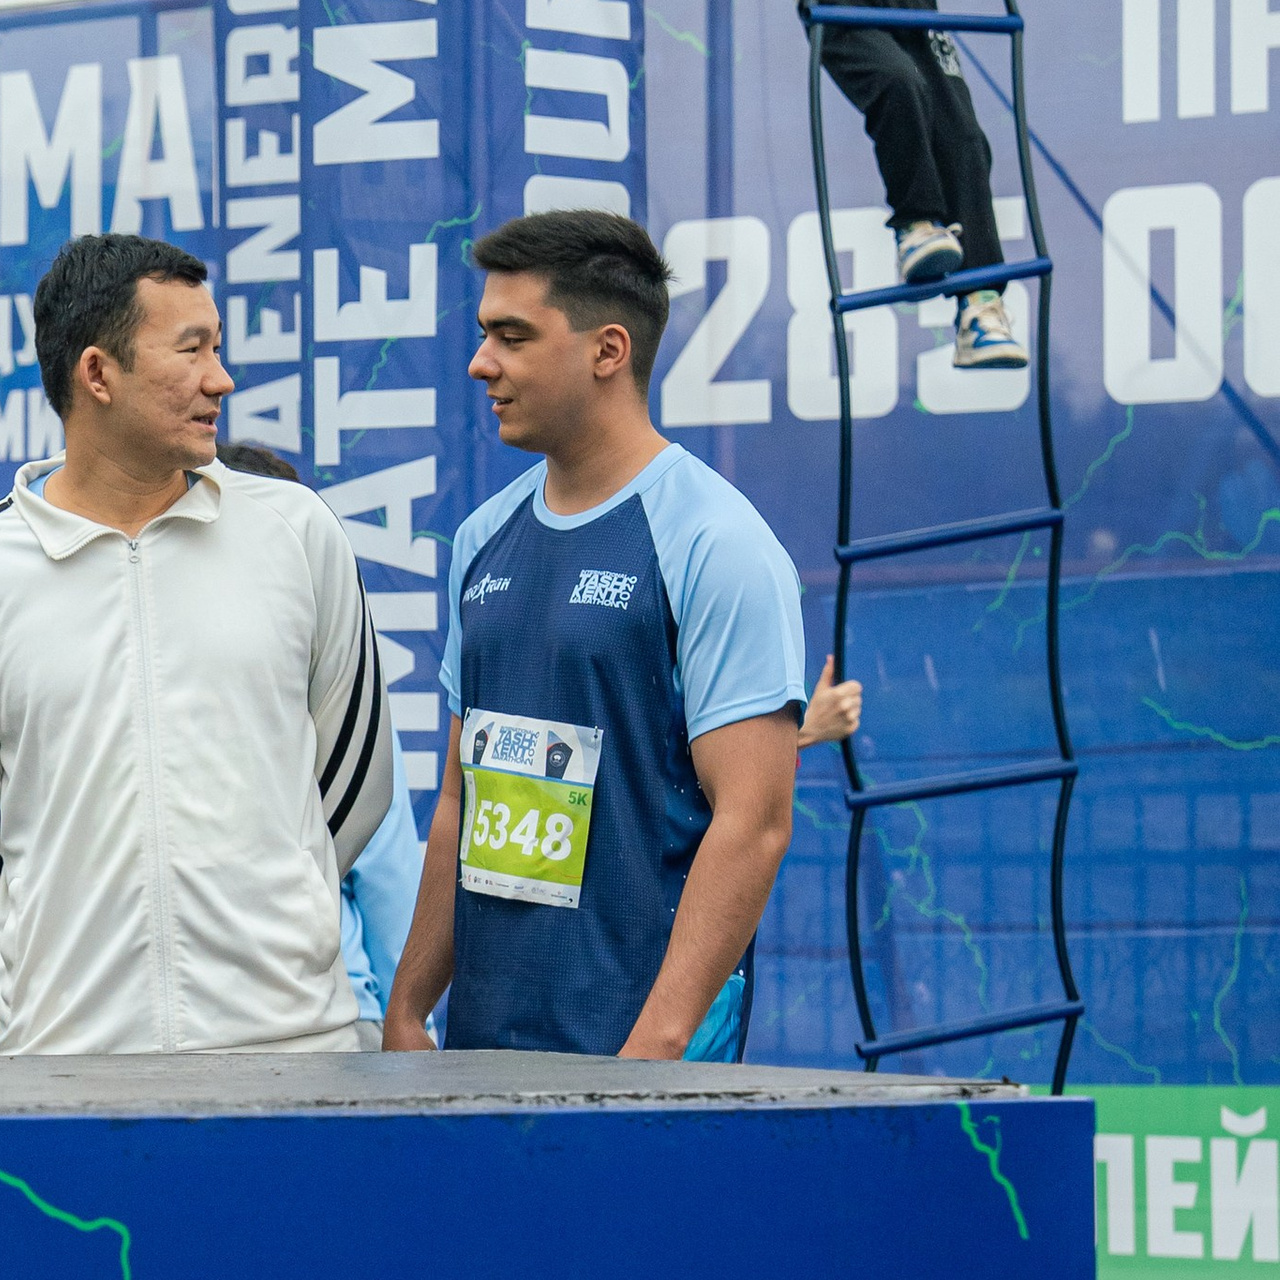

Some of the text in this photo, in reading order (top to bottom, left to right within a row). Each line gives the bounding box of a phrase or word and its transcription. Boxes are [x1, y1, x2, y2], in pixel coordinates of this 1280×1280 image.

[579, 572, 629, 591] TASH
[569, 585, 624, 605] KENT
[615, 575, 638, 610] 2026
[499, 730, 535, 750] TASH
[492, 740, 527, 761] KENT
[568, 791, 588, 806] 5K
[473, 799, 574, 861] 5348
